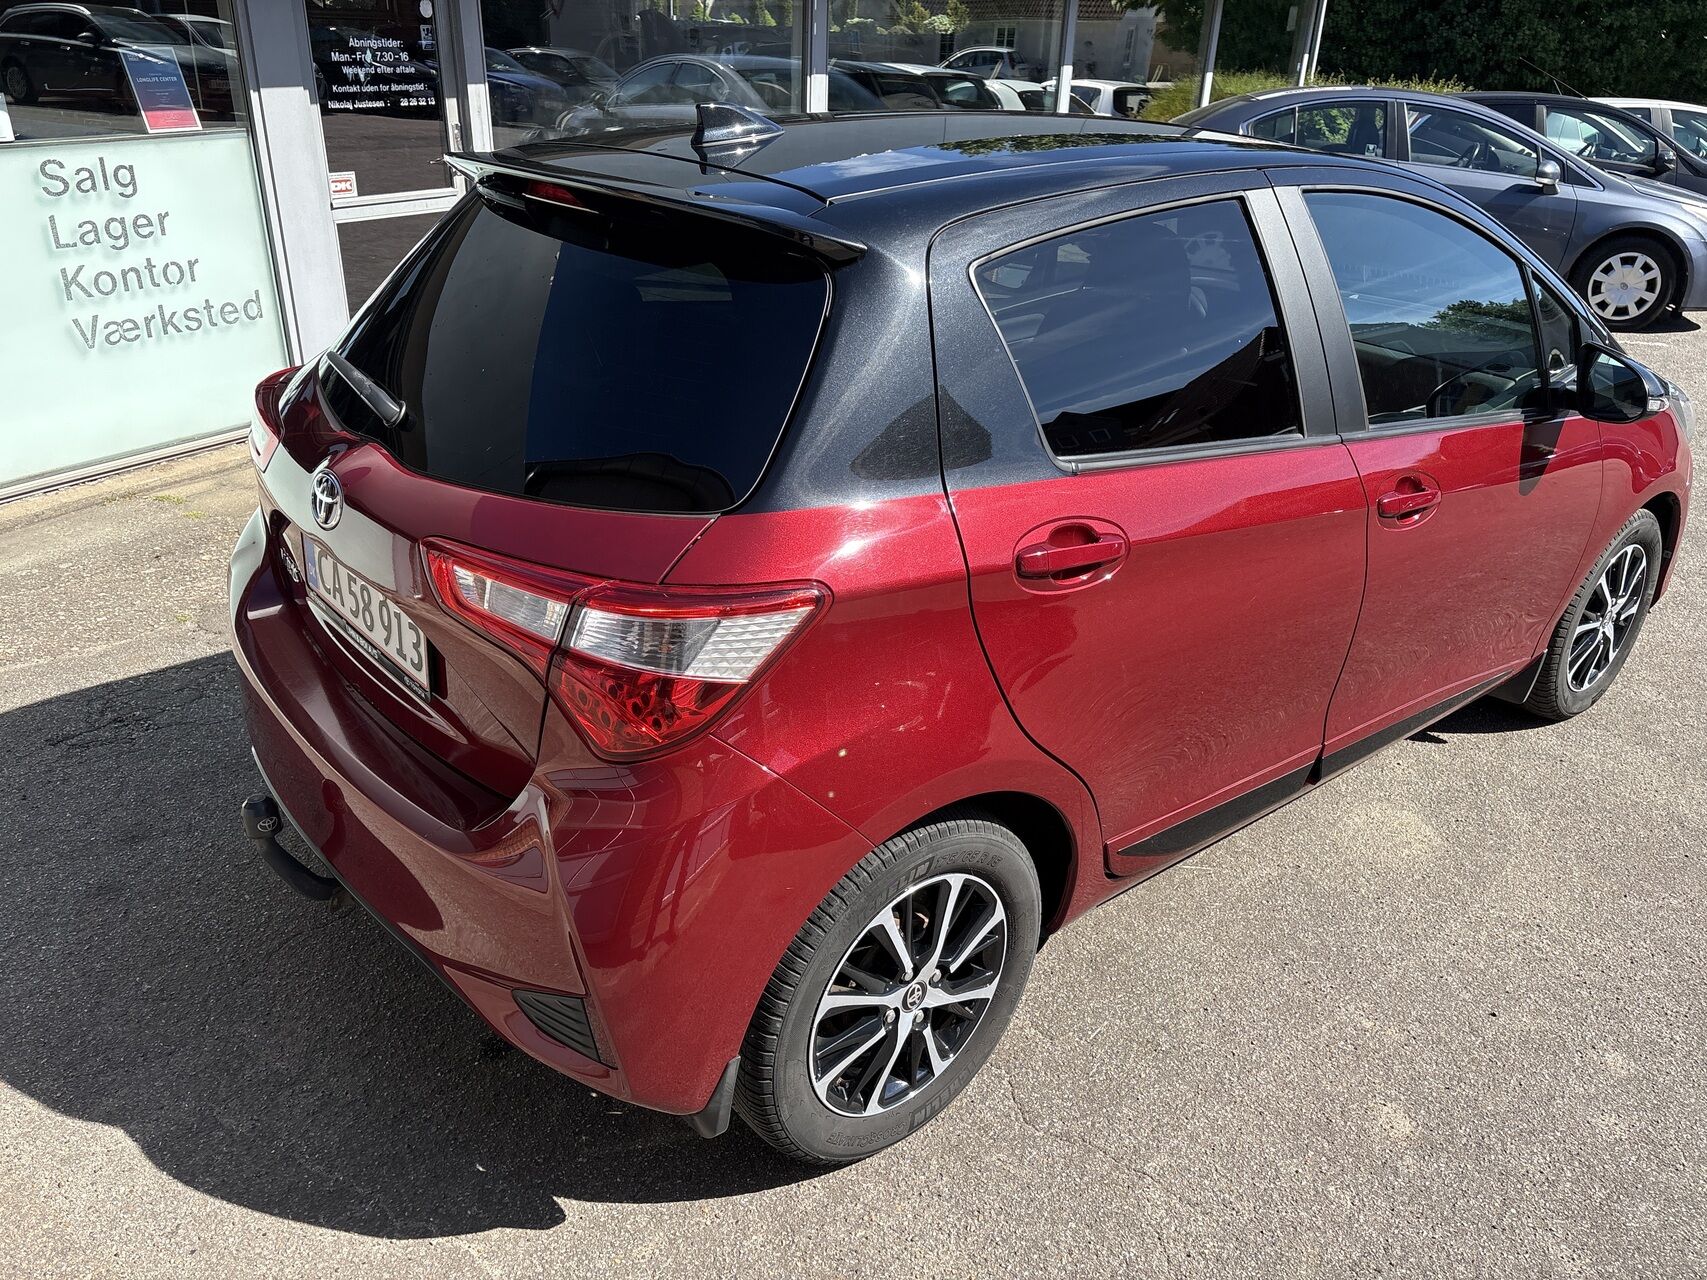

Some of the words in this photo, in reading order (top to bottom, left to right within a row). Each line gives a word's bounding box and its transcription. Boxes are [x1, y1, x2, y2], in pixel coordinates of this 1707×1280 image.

[349, 36, 404, 49] Åbningstider:
[332, 84, 360, 93] Kontakt
[361, 84, 379, 92] uden
[379, 84, 390, 92] for
[341, 65, 375, 74] Weekend
[376, 65, 394, 74] efter
[395, 65, 415, 74] aftale
[328, 100, 353, 110] Nikolaj
[353, 99, 385, 109] Justesen
[39, 157, 138, 198] Salg
[48, 211, 170, 251] Lager
[60, 257, 199, 301] Kontor
[72, 289, 264, 349] Værksted
[318, 549, 345, 607] CA
[347, 572, 374, 632] 58
[379, 599, 423, 672] 913
